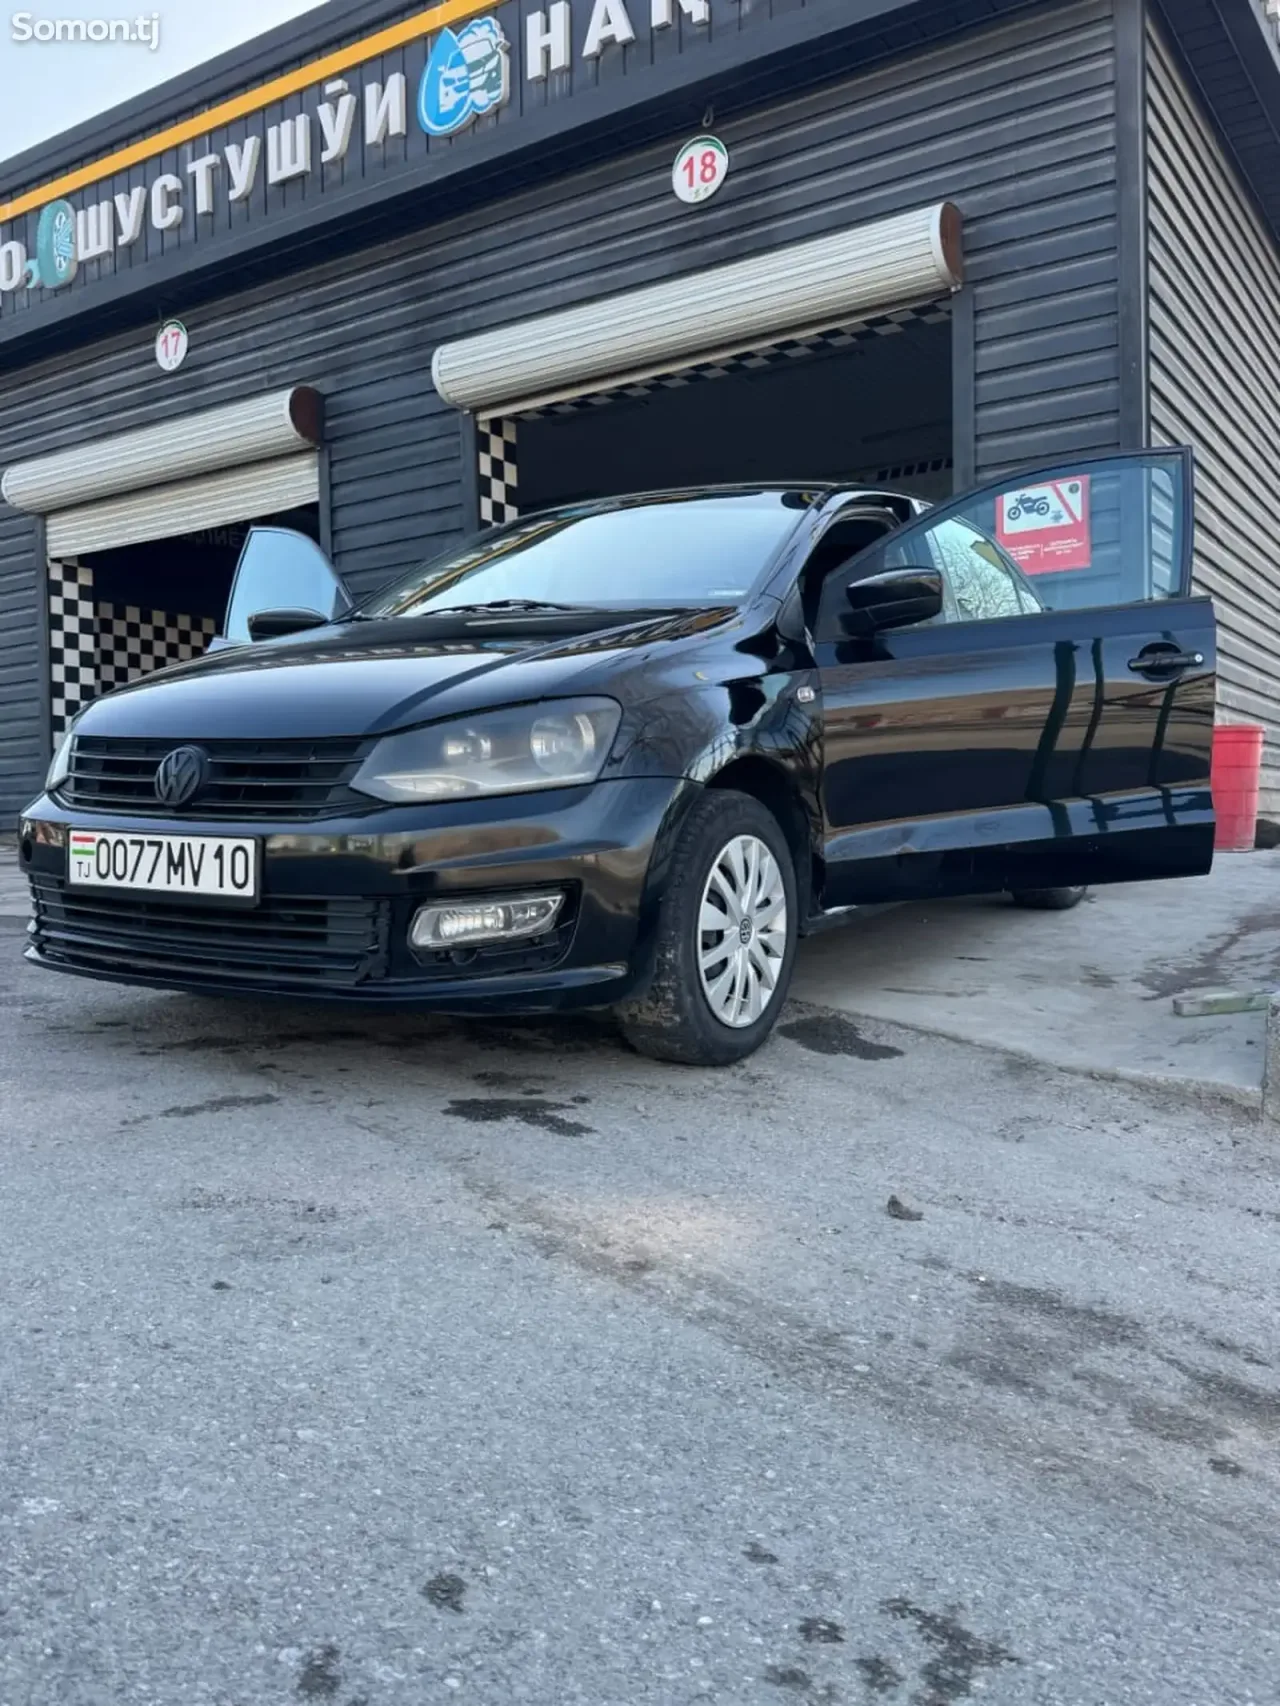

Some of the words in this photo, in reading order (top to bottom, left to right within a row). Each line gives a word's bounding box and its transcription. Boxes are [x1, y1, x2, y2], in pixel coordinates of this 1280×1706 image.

[682, 150, 717, 188] 18
[161, 331, 180, 360] 17
[76, 861, 91, 878] TJ
